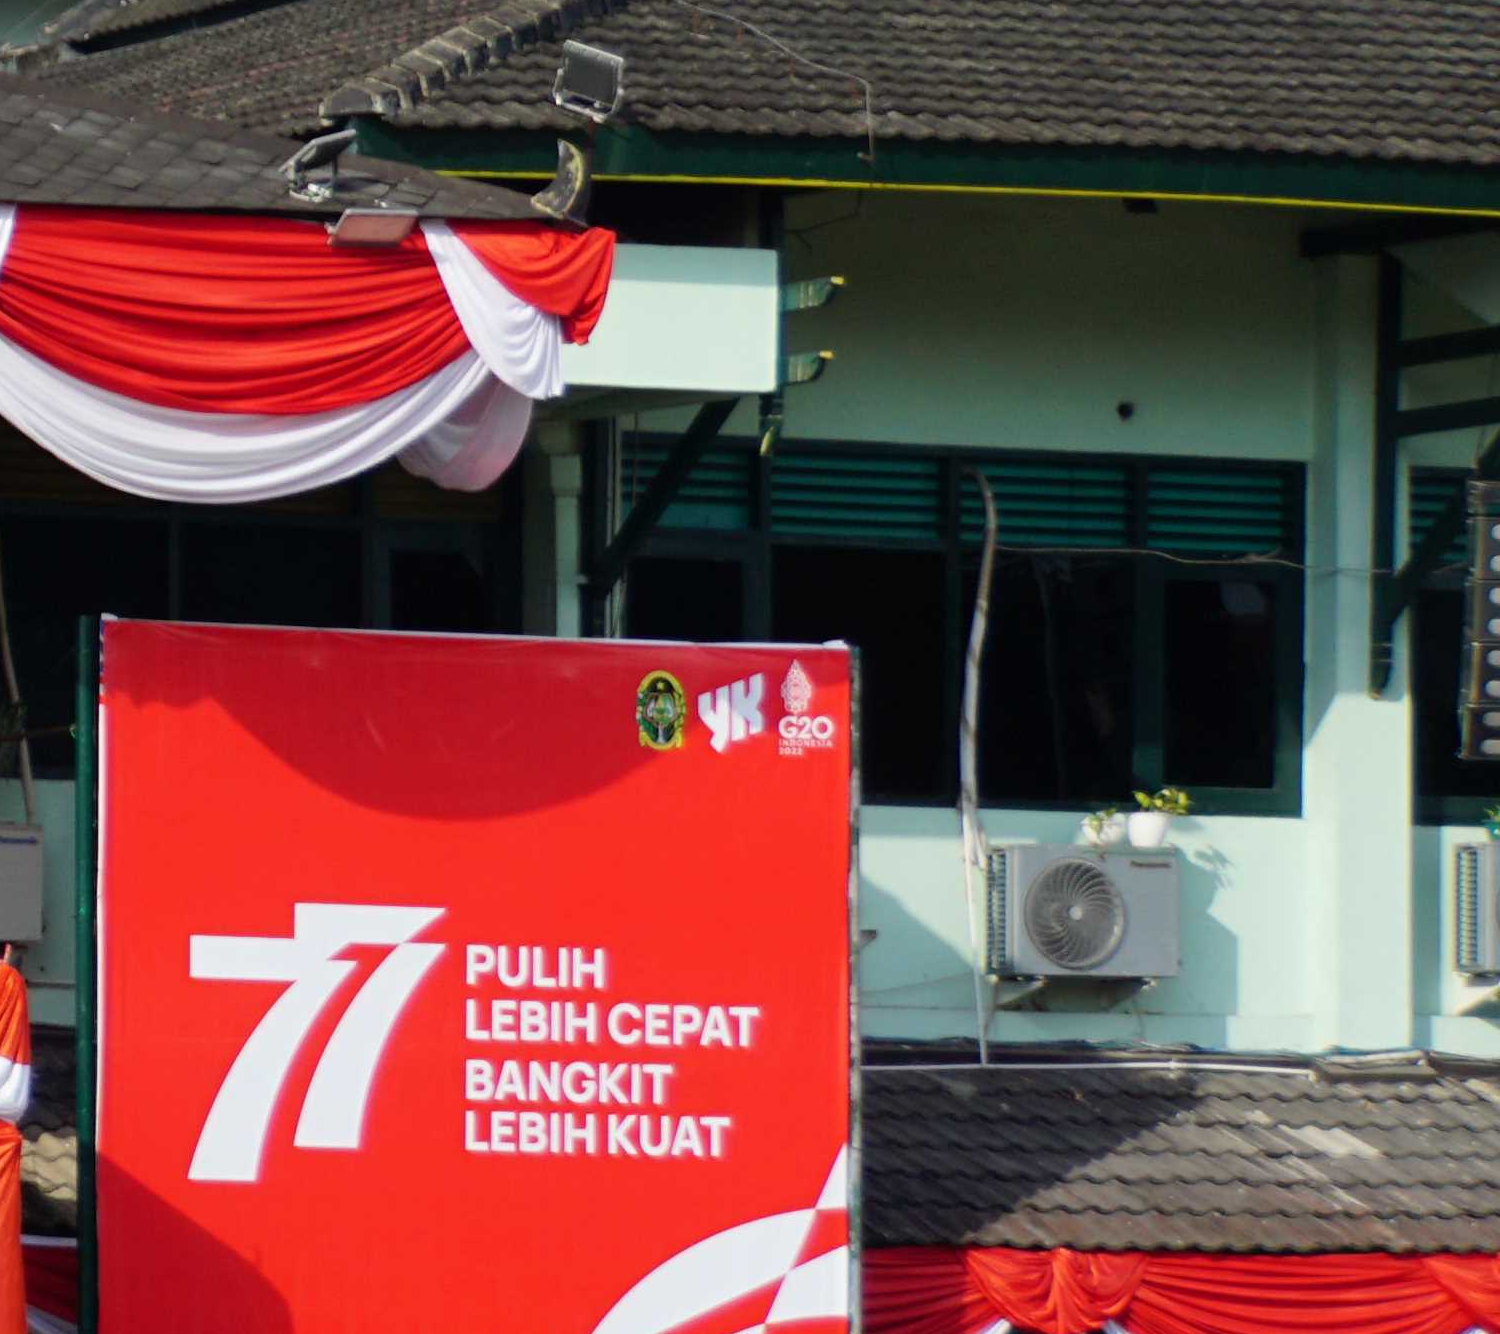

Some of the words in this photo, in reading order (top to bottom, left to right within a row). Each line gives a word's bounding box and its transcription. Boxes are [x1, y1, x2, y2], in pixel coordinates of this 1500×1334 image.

[698, 673, 765, 753] YK
[778, 715, 835, 740] G20
[779, 739, 833, 748] INDONESIA
[779, 747, 803, 756] 2022
[465, 944, 606, 990] PULIH
[187, 902, 447, 1183] 77
[465, 999, 598, 1044] LEBIH
[607, 1002, 760, 1048] CEPAT
[465, 1059, 675, 1105] BANGKIT
[465, 1110, 598, 1155] LEBIH
[607, 1113, 733, 1158] KUAT
